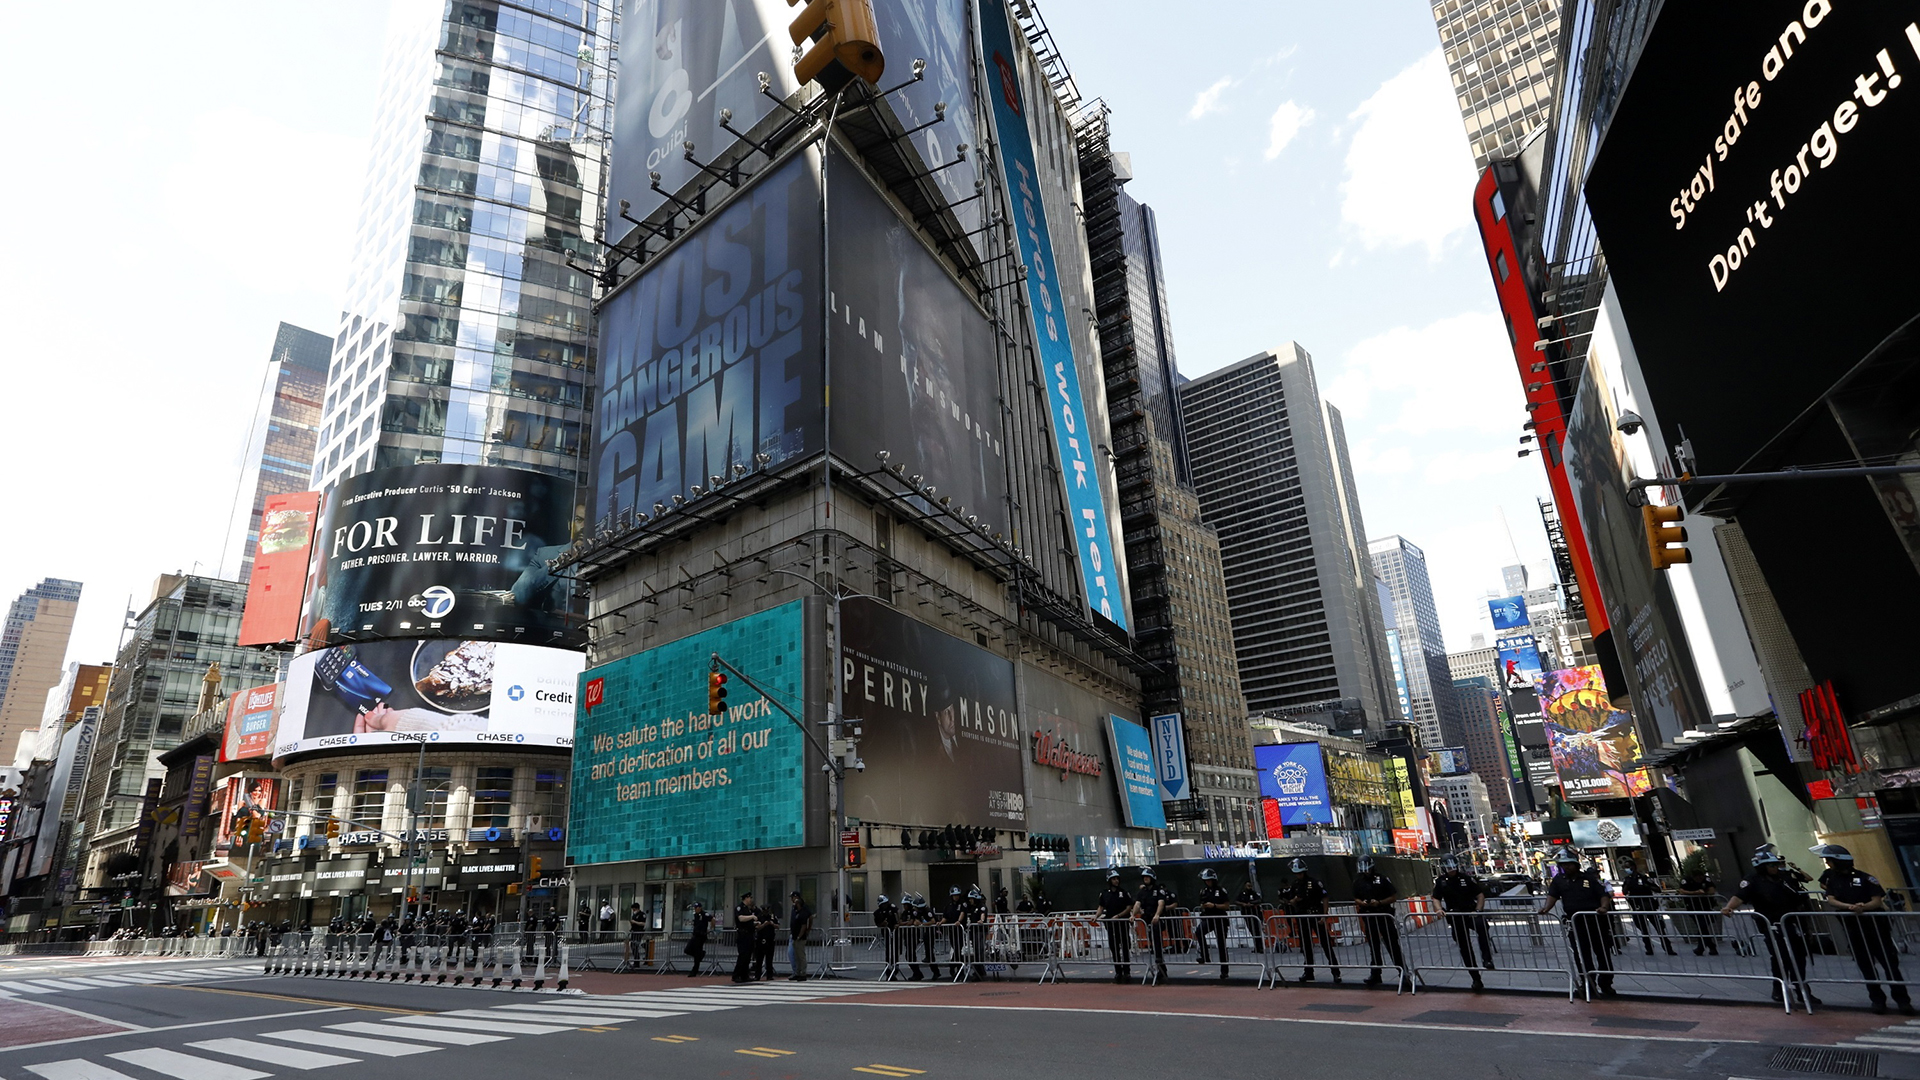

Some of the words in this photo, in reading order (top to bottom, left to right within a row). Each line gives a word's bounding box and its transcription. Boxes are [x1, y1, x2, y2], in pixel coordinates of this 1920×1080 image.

[646, 120, 688, 170] Quibi
[1670, 154, 1715, 230] Stay
[1715, 80, 1761, 162] safe
[1708, 205, 1774, 293] Don't
[1770, 47, 1902, 211] forget!
[603, 173, 799, 394] MOST
[602, 269, 805, 439] DANGEROUS
[831, 291, 883, 354] LIAM
[900, 355, 1000, 457] HEMSWORTH
[1014, 157, 1058, 342] Heroes
[1054, 361, 1088, 490] work
[1082, 508, 1112, 621] here
[596, 327, 803, 538] GAME
[355, 490, 382, 503] Executive
[384, 486, 417, 496] Producer
[420, 485, 443, 493] Curtis
[488, 487, 522, 499] Jackson
[330, 516, 399, 559] FOR
[416, 514, 527, 550] LIFE
[341, 557, 365, 571] FATHER.
[367, 553, 410, 566] PRISONER.
[413, 552, 451, 562] LAWYER.
[456, 552, 500, 564] WARRIOR.
[359, 602, 383, 612] TUES
[385, 600, 403, 611] 2/11
[407, 597, 427, 608] abc
[886, 661, 909, 675] MATTHEW
[1635, 638, 1669, 683] D'ANGELO
[1387, 636, 1402, 682] TIMES
[1397, 687, 1410, 720] SQU
[535, 690, 573, 704] Credit
[843, 657, 928, 717] PERRY
[959, 696, 1019, 741] MASON
[83, 707, 99, 725] NEW
[246, 719, 267, 732] BURGER
[593, 733, 614, 754] We
[616, 723, 657, 750] salute
[661, 717, 684, 739] the
[728, 695, 772, 724] work
[278, 743, 293, 755] CHASE
[319, 736, 348, 747] CHASE
[391, 732, 428, 742] CHASE
[477, 733, 514, 742] CHASE
[1160, 720, 1177, 780] NYPD
[591, 759, 615, 781] and
[618, 746, 694, 774] dedication
[697, 734, 714, 759] of
[718, 730, 736, 755] all
[741, 727, 772, 751] our
[1033, 730, 1101, 781] Walgreens
[67, 755, 88, 791] STUDIOS
[191, 758, 210, 805] VICTORY
[616, 779, 651, 802] team
[655, 767, 732, 796] members.
[1563, 780, 1574, 789] DA
[1574, 778, 1581, 790] 5
[1581, 777, 1612, 788] BLOODS
[989, 790, 1001, 800] JUNE
[1008, 792, 1024, 811] HBO
[989, 800, 995, 809] AT
[186, 811, 199, 833] NEW
[338, 832, 380, 845] CHASE
[332, 871, 345, 879] LIVES
[345, 870, 365, 878] MATTER
[403, 868, 418, 876] LIES
[479, 865, 494, 873] LIVES
[494, 864, 515, 872] MATTER
